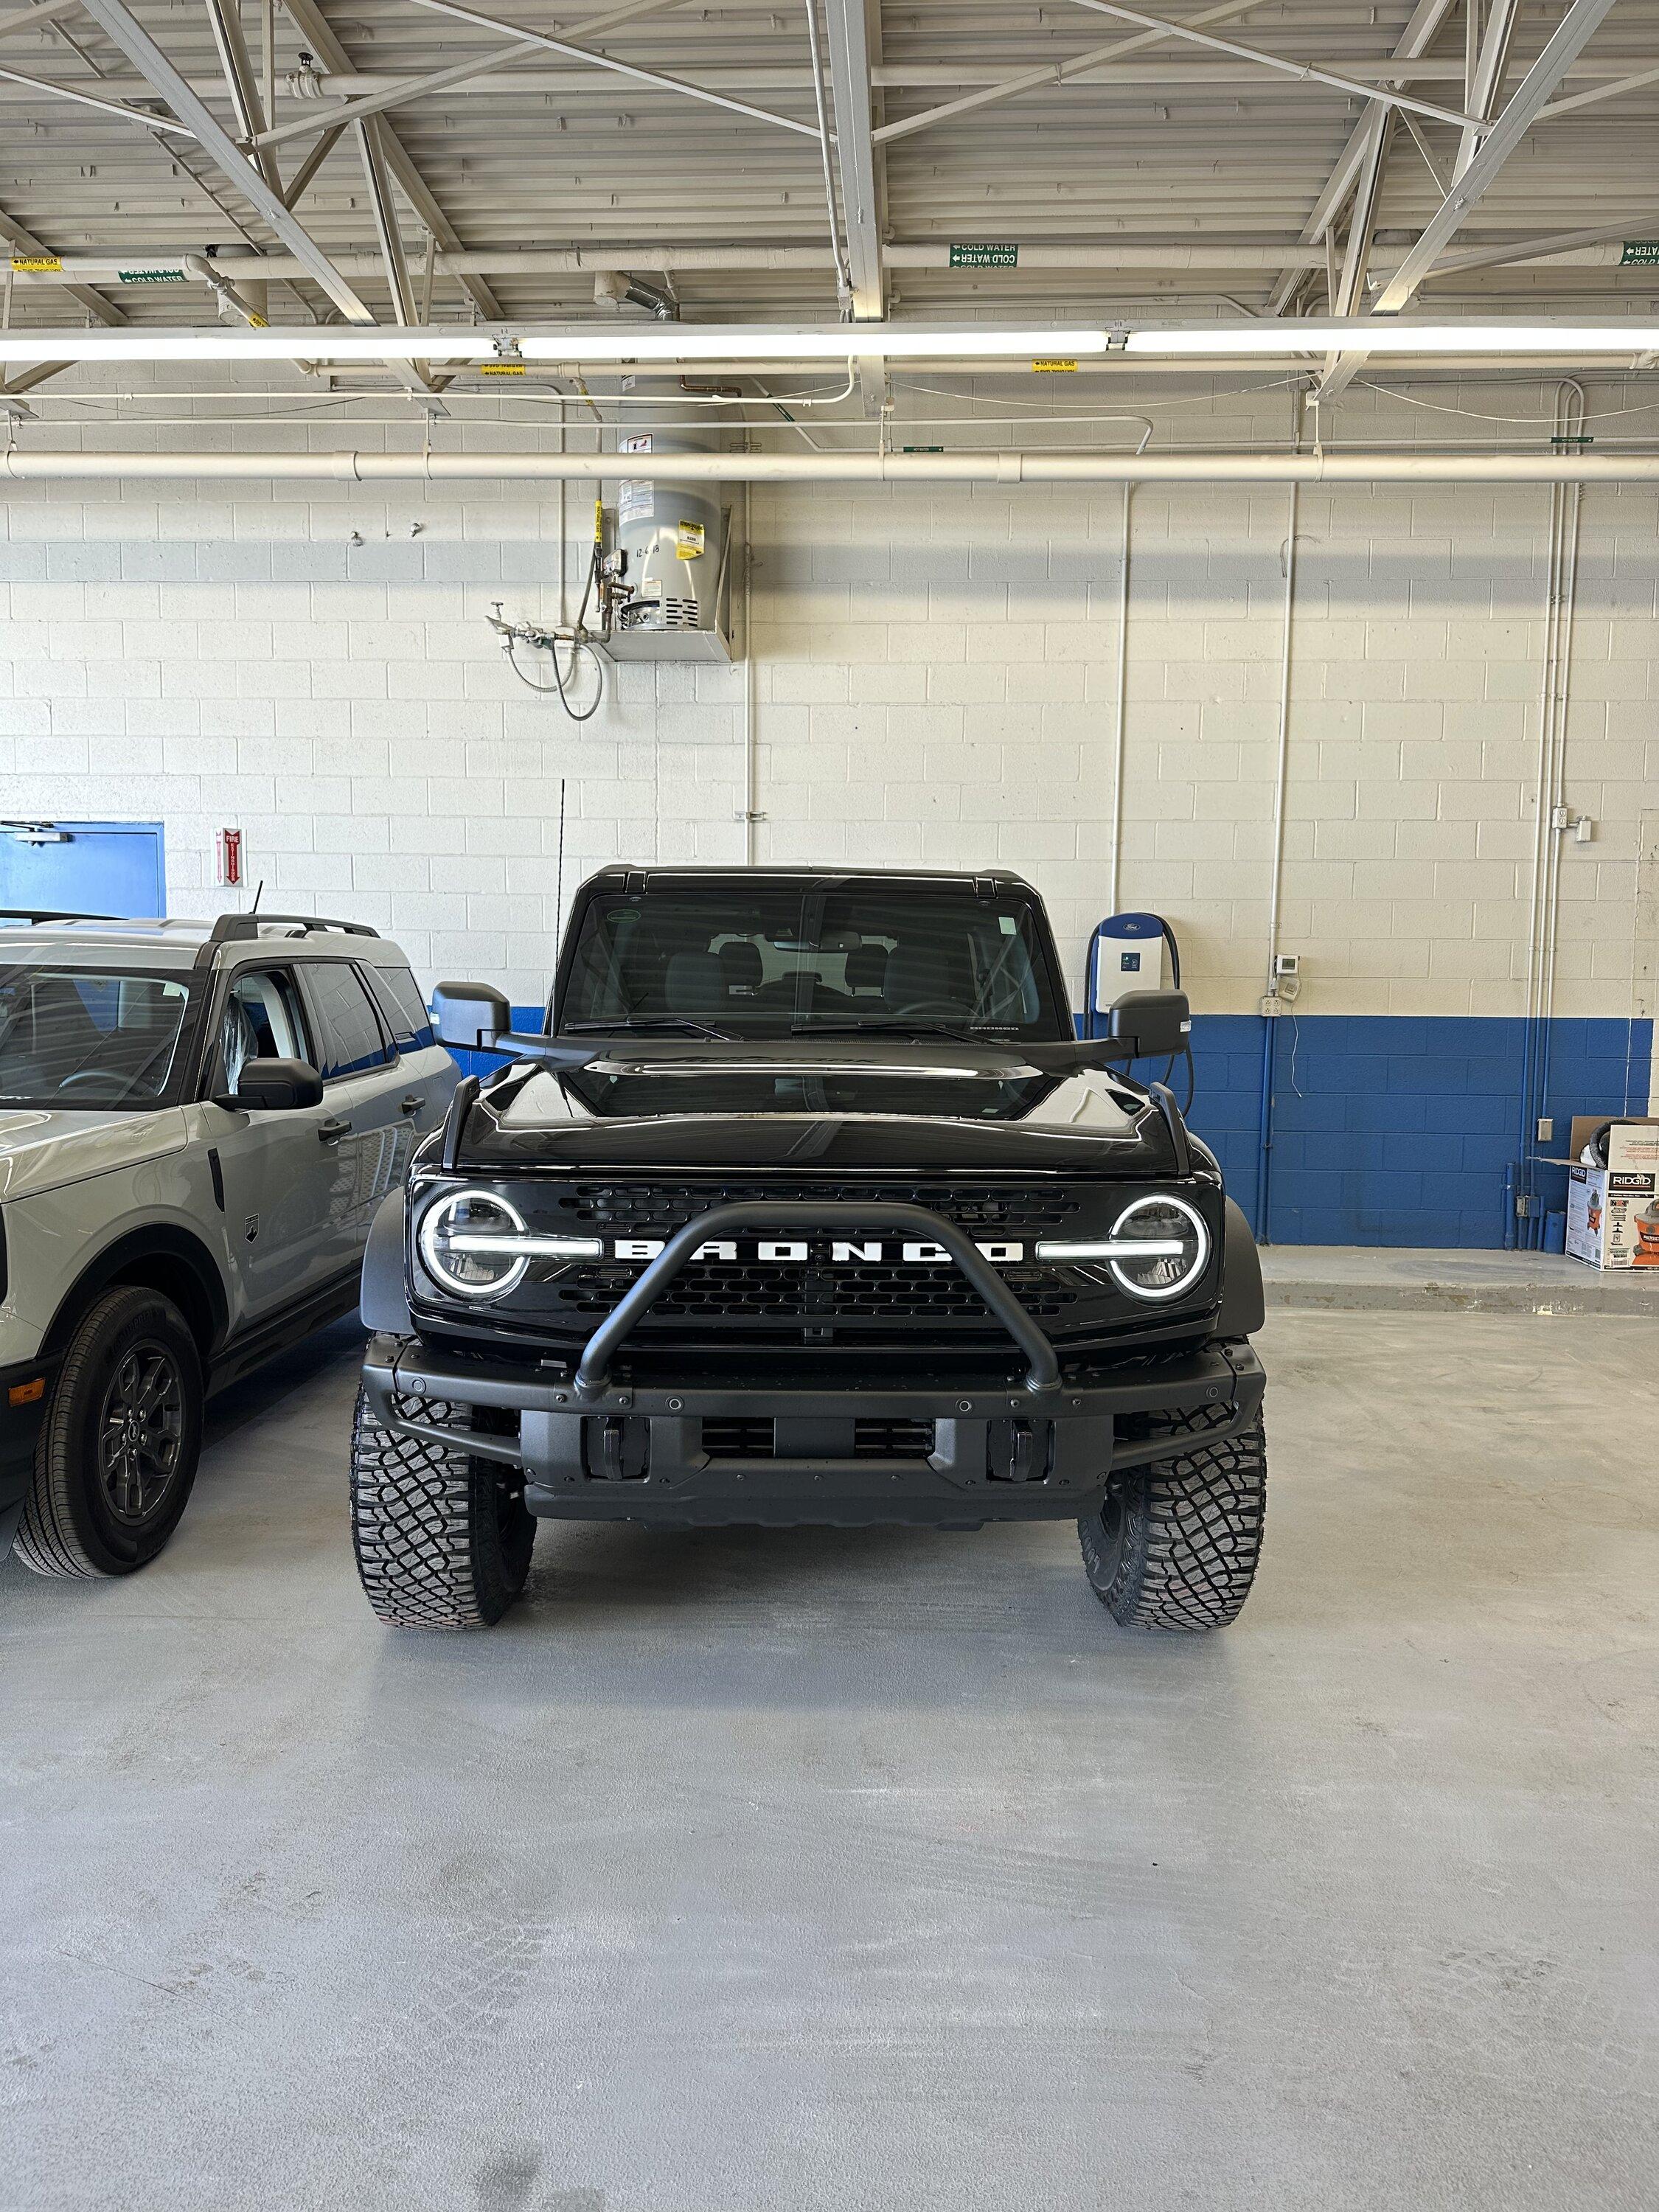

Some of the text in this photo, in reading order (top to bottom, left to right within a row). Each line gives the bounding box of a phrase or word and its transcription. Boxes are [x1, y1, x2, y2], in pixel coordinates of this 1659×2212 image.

[1635, 247, 1659, 255] ATER
[961, 254, 1015, 263] COLD WATER
[1613, 1176, 1652, 1185] RIDGID
[614, 1239, 1023, 1262] BRONCO
